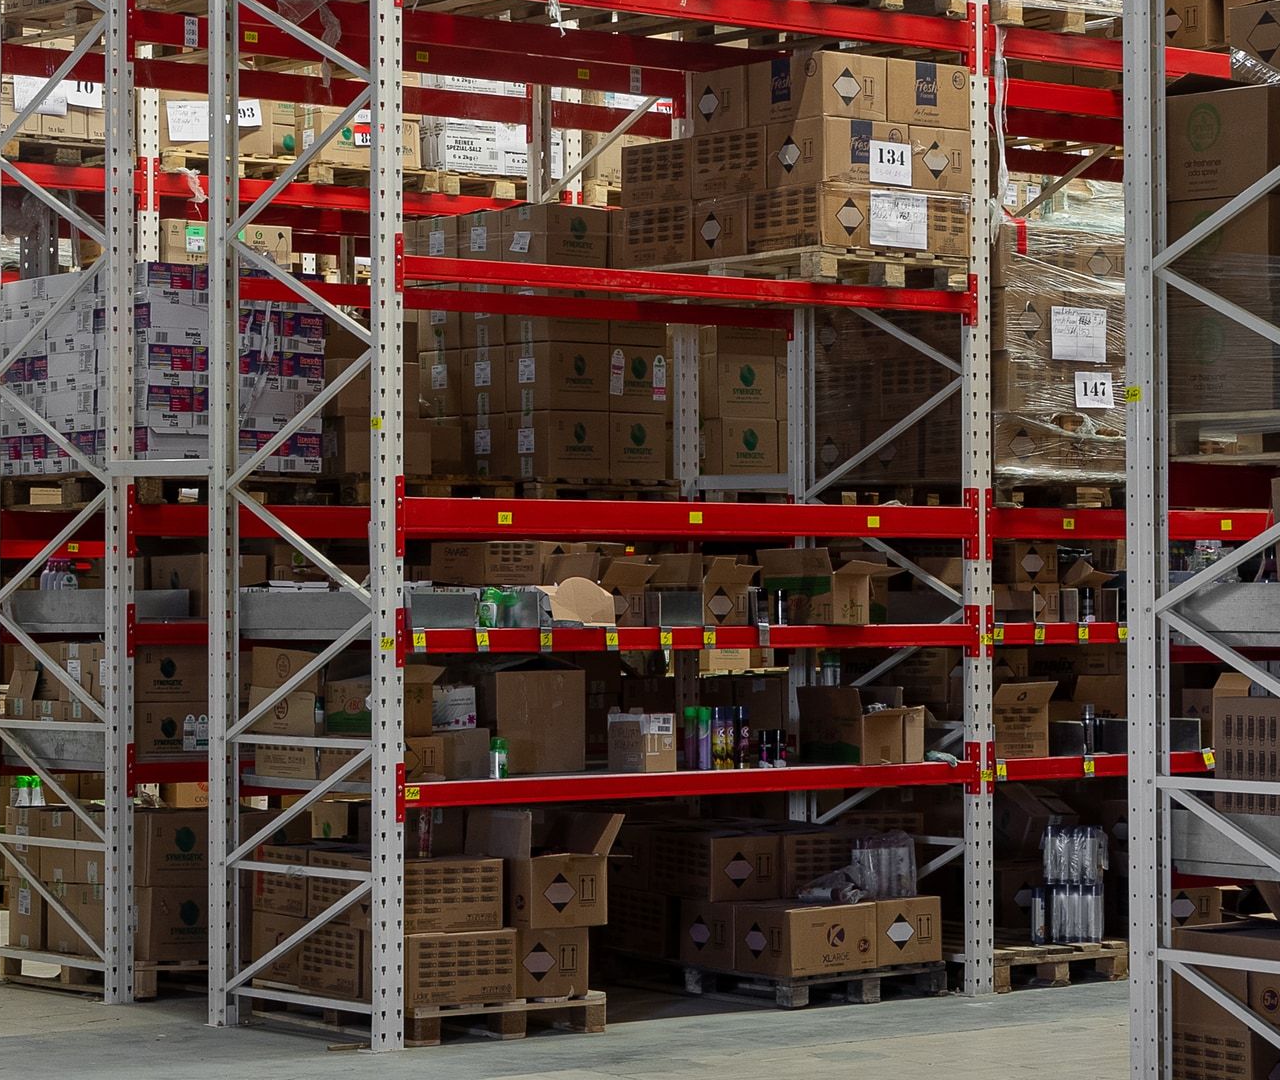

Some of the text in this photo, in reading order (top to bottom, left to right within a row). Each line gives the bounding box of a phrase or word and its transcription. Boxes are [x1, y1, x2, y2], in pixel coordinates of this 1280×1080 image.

[914, 79, 938, 94] Fresh
[446, 144, 482, 153] SPEZIAL-SALZ
[878, 148, 906, 165] 134
[733, 388, 764, 397] SYNERGETIC
[1081, 381, 1107, 397] 147
[736, 451, 765, 460] SYNERGETIC
[152, 678, 183, 687] SYNERGETIC
[165, 853, 204, 862] SYNERGETIC
[822, 952, 850, 962] XLARGE
